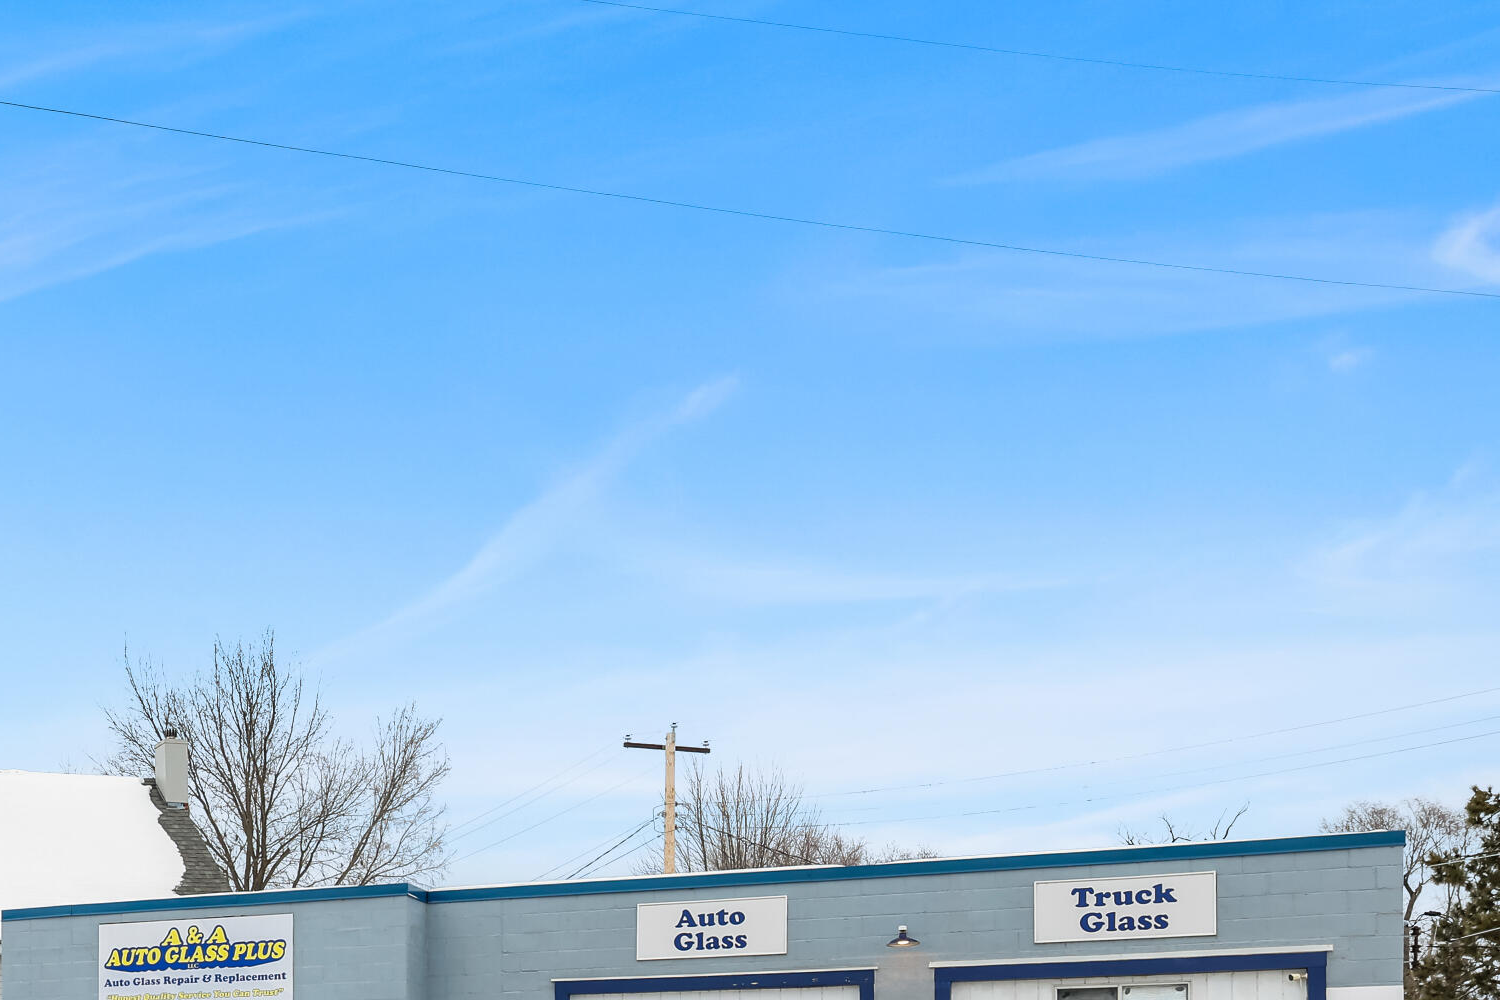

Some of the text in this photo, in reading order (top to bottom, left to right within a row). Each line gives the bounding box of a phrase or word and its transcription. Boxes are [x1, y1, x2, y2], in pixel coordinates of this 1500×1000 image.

[1071, 884, 1177, 907] Truck
[675, 909, 746, 928] Auto
[1080, 912, 1169, 932] Glass
[161, 925, 228, 947] A & A
[673, 932, 748, 951] Glass
[105, 941, 286, 968] AUTO GLASS PLUS
[104, 972, 287, 988] Auto Glass Repair & Replacement
[178, 991, 211, 1000] Service
[213, 989, 231, 998] You
[232, 989, 251, 998] Can
